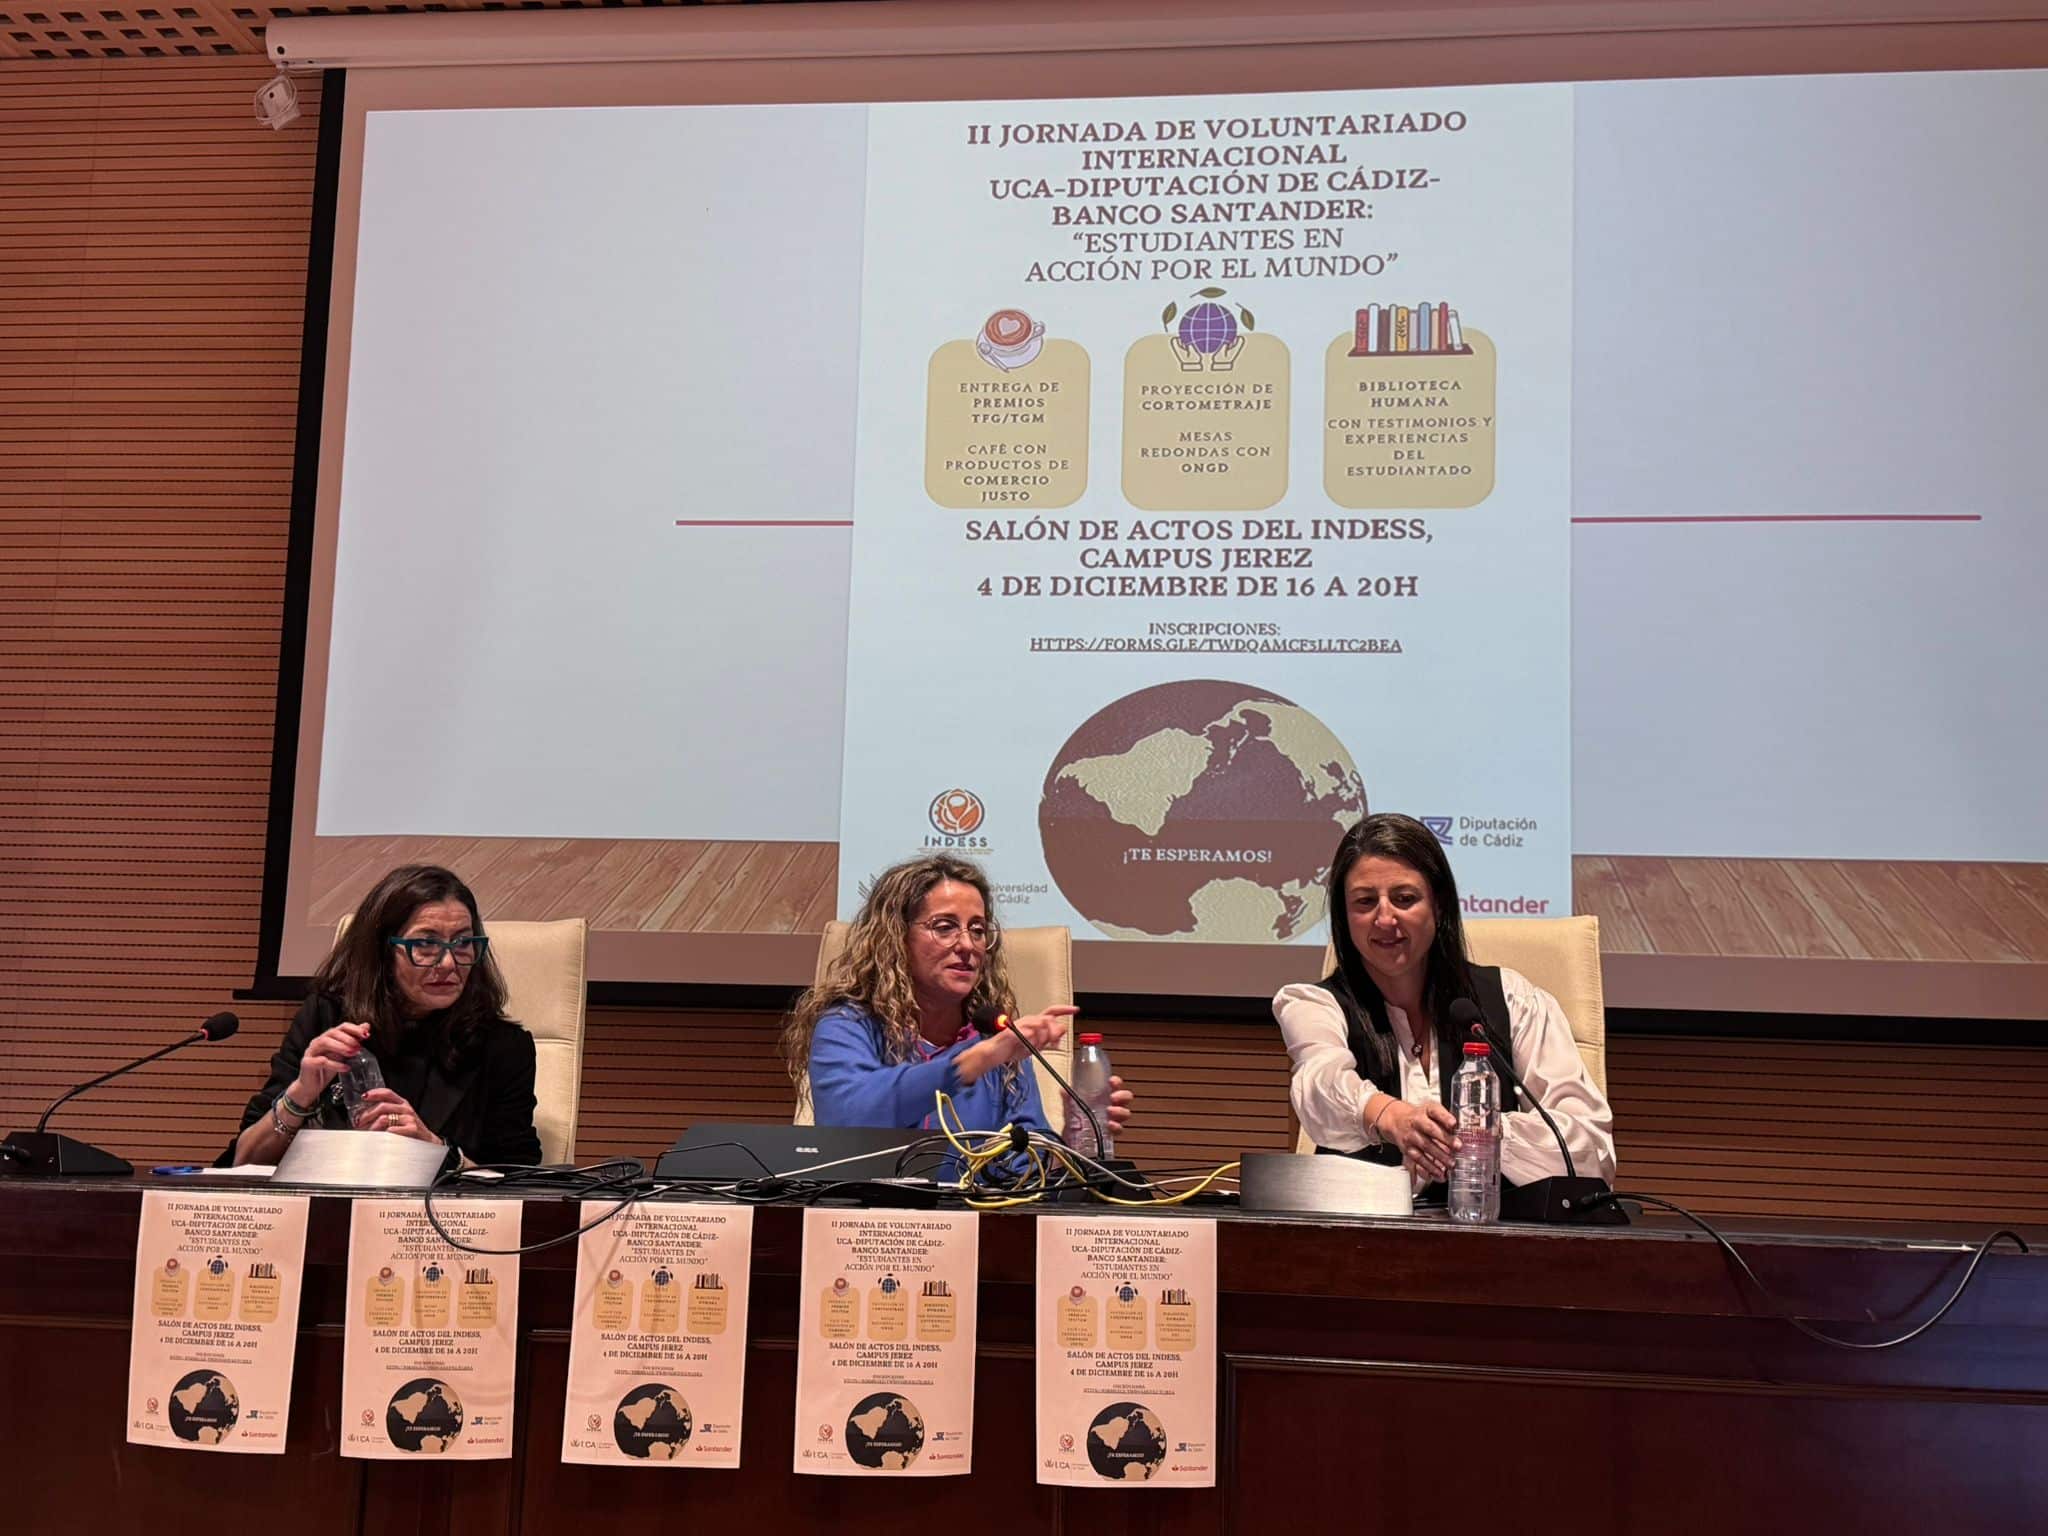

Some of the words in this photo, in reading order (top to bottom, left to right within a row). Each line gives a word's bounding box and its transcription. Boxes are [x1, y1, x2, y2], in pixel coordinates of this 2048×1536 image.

[967, 125, 991, 144] II
[999, 122, 1147, 148] JORNADA
[1155, 120, 1196, 141] DE
[1203, 111, 1467, 139] VOLUNTARIADO
[1082, 144, 1347, 170] INTERNACIONAL
[990, 169, 1269, 200] UCA-DIPUTACIÓN
[1277, 172, 1318, 193] DE
[1327, 165, 1440, 192] CÁDIZ-
[1052, 204, 1162, 225] BANCO
[1171, 199, 1373, 224] SANTANDER:
[1304, 227, 1344, 248] EN
[1024, 255, 1142, 282] ACCIÓN
[1151, 259, 1212, 280] POR
[1221, 258, 1256, 279] EL
[959, 382, 1033, 393] ENTREGA
[1039, 381, 1060, 393] DE
[1141, 382, 1246, 396] PROYECCIÓN
[1252, 383, 1273, 394] DE
[1359, 380, 1462, 392] BIBLIOTECA
[973, 397, 1045, 409] PREMIOS
[1141, 399, 1272, 411] CORTOMETRAJE
[1370, 396, 1449, 408] HUMANA
[971, 412, 1045, 425] TFG/TGM
[1327, 418, 1361, 430] CON
[1367, 416, 1477, 429] TESTIMONIOS
[1482, 416, 1493, 427] Y
[1179, 431, 1233, 442] MESAS
[1345, 432, 1469, 445] EXPERIENCIAS
[967, 442, 1007, 455] CAFÉ
[1012, 444, 1047, 455] CON
[1140, 446, 1230, 458] REDONDAS
[1235, 446, 1271, 457] CON
[1393, 449, 1425, 461] DEL
[945, 459, 1042, 471] PRODUCTOS
[1048, 459, 1069, 470] DE
[1181, 462, 1229, 474] ONGD
[1347, 464, 1472, 477] ESTUDIANTADO
[963, 475, 1050, 486] COMERCIO
[981, 490, 1031, 504] JUSTO
[966, 515, 1070, 541] SALÓN
[1079, 520, 1118, 540] DE
[1127, 520, 1233, 541] ACTOS
[1242, 519, 1302, 540] DEL
[1310, 519, 1433, 544] INDESS,
[1080, 548, 1212, 569] CAMPUS
[1220, 548, 1312, 572] JEREZ
[977, 577, 992, 596] 4
[1001, 576, 1041, 596] DE
[1049, 576, 1228, 597] DICIEMBRE
[1236, 576, 1278, 597] DE
[1286, 577, 1315, 597] 16
[1327, 576, 1348, 597] A
[1357, 576, 1418, 597] 20H
[1148, 622, 1281, 637] INSCRIPCIONES:
[1459, 816, 1537, 831] Diputación
[924, 835, 988, 848] INDESS
[1459, 834, 1478, 847] de
[1483, 833, 1524, 847] Cádiz
[1156, 848, 1272, 863] ESPERAMOS!
